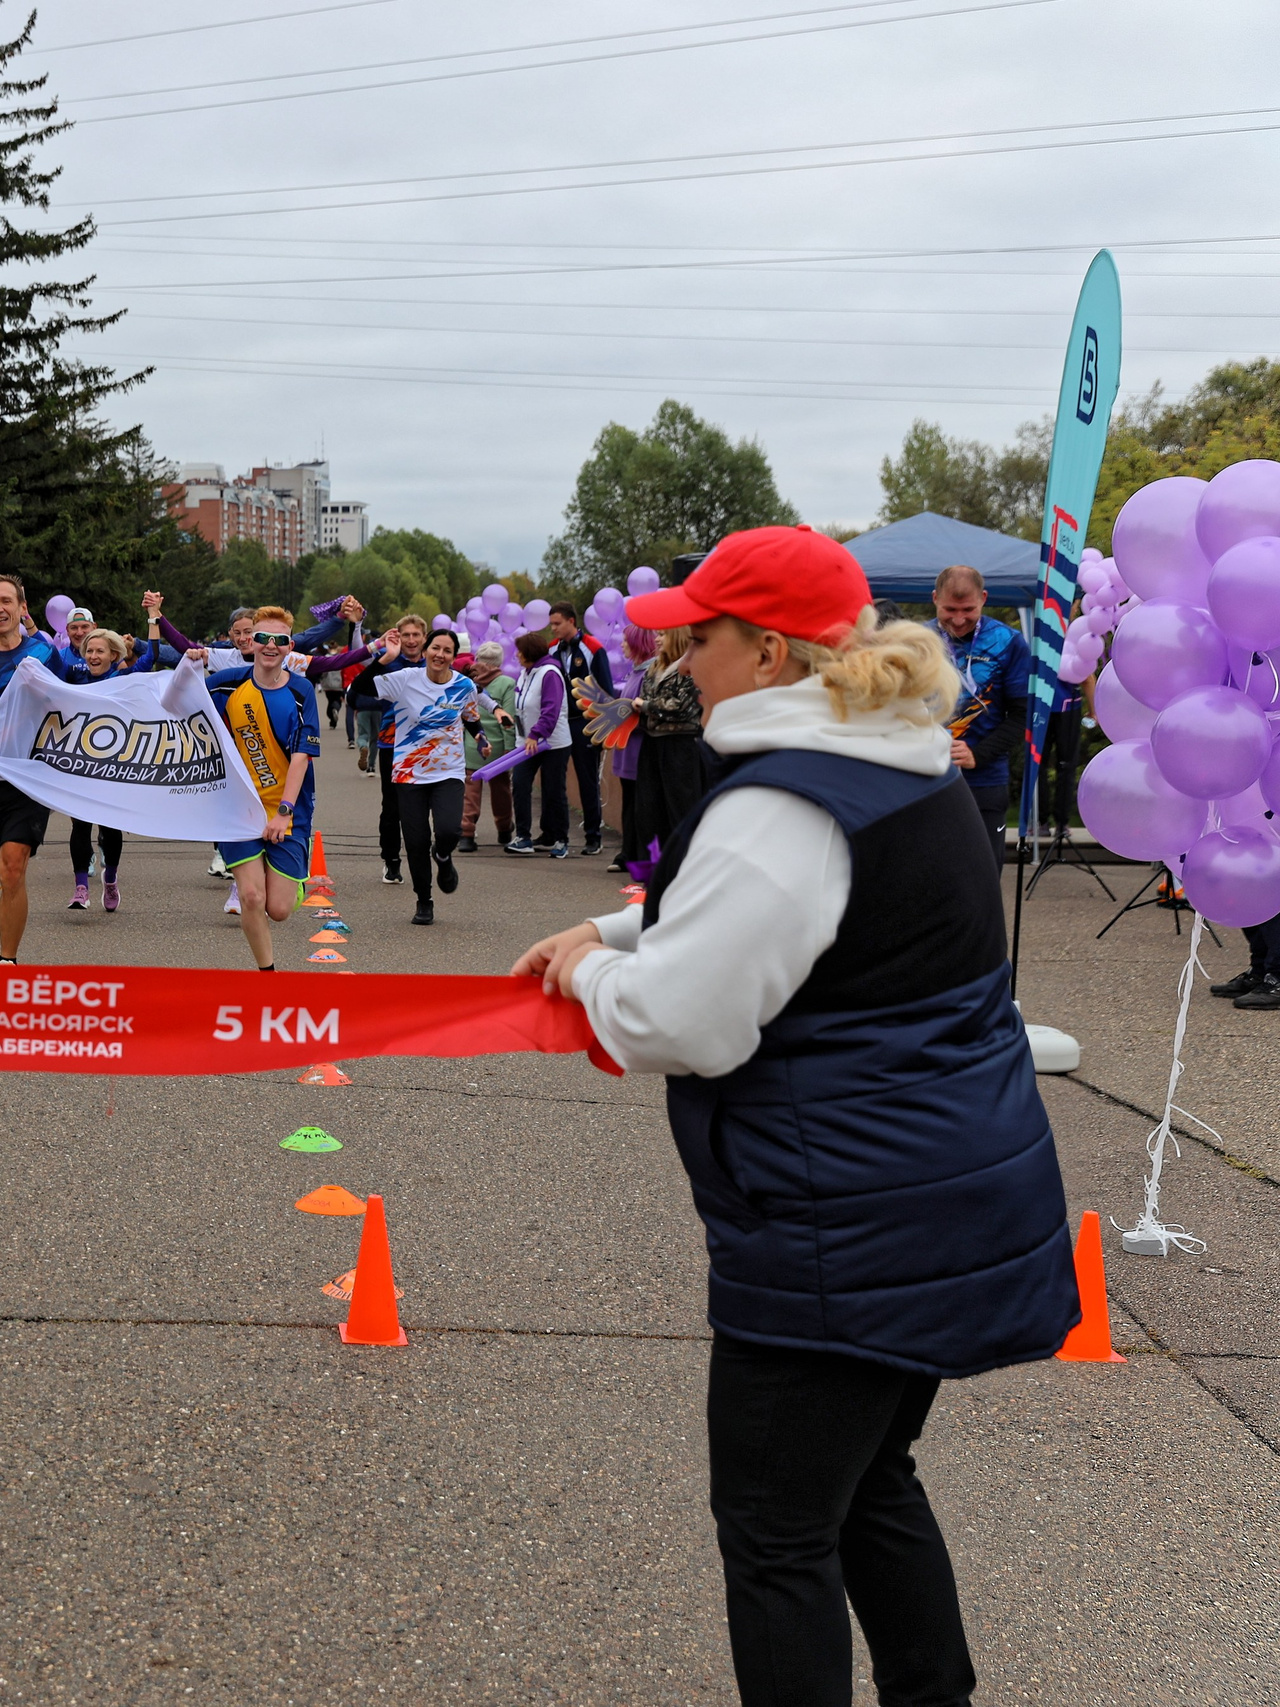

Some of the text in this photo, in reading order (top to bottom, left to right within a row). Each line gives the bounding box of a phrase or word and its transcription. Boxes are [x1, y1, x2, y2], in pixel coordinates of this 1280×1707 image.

[33, 710, 221, 765] МОЛНИЯ
[236, 724, 278, 788] МОЛНИЯ
[160, 757, 225, 783] ЖУРНАЛ
[169, 781, 227, 796] molniya26.ru
[6, 974, 125, 1008] ВЁРСТ
[213, 1005, 340, 1045] 5 КМ
